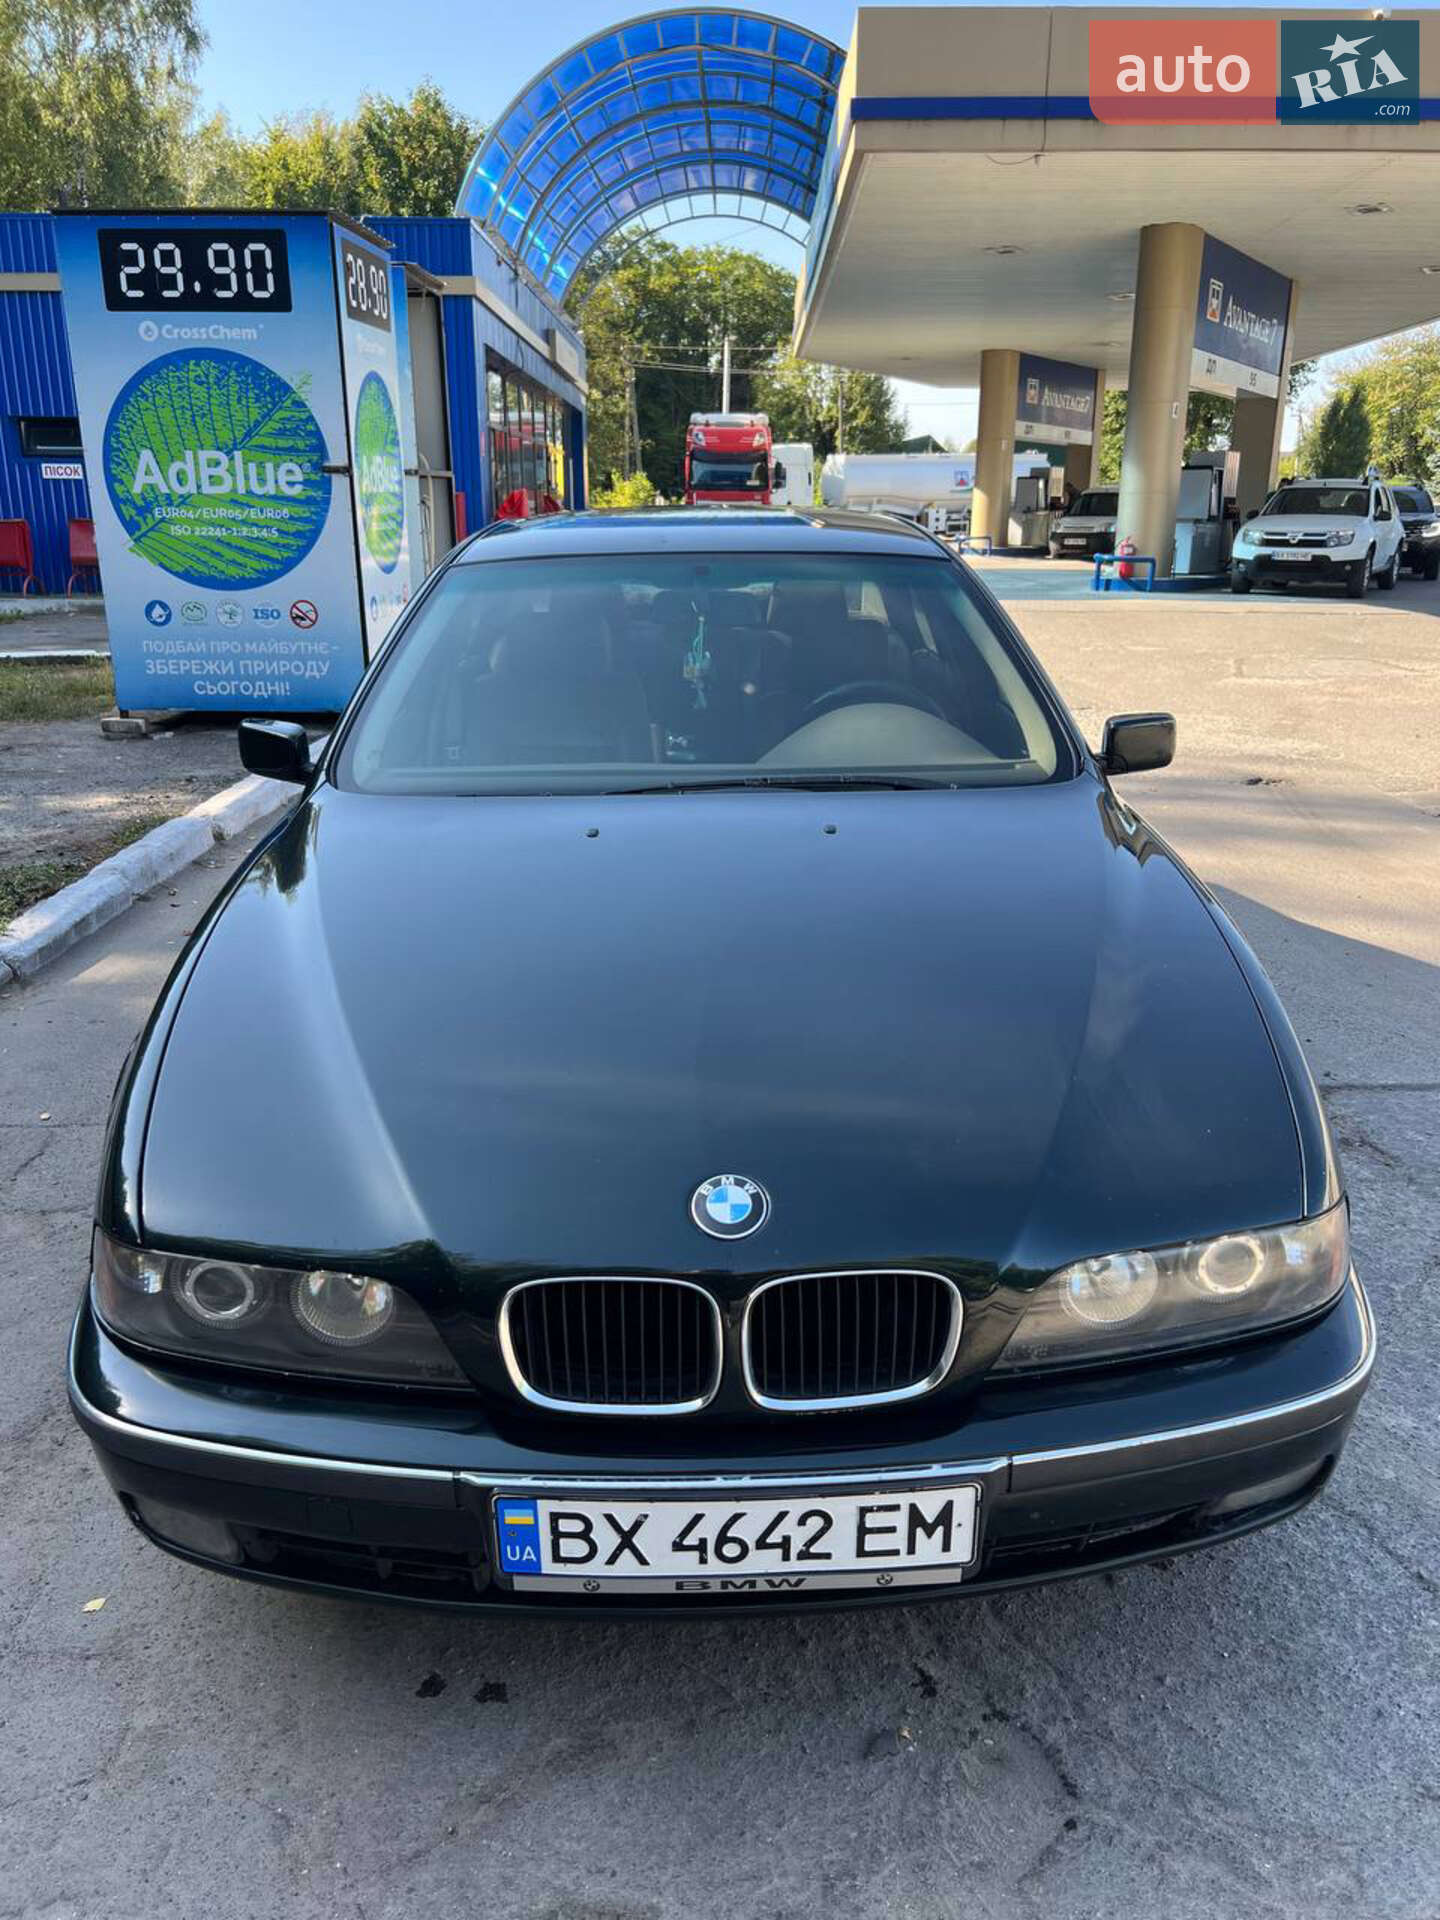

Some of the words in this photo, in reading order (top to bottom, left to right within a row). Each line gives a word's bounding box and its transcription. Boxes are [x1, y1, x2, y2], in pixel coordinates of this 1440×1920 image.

[119, 242, 275, 299] 29.90
[346, 253, 388, 320] 28.90
[161, 323, 259, 341] CrossChem
[44, 465, 81, 477] ПІСОК
[170, 525, 192, 536] ISO
[253, 607, 281, 622] ISO
[143, 638, 206, 655] ПОДБАЙ
[210, 640, 241, 653] ПРО
[145, 659, 234, 675] ЗБЕРЕЖИ
[239, 659, 331, 679] ПРИРОДУ
[193, 680, 291, 698] СЬОГОДНІ!
[699, 1176, 758, 1196] BMW
[549, 1512, 650, 1566] BX
[671, 1509, 834, 1565] 4642
[855, 1499, 955, 1558] EM
[507, 1544, 537, 1562] UA
[675, 1578, 807, 1591] BMW
